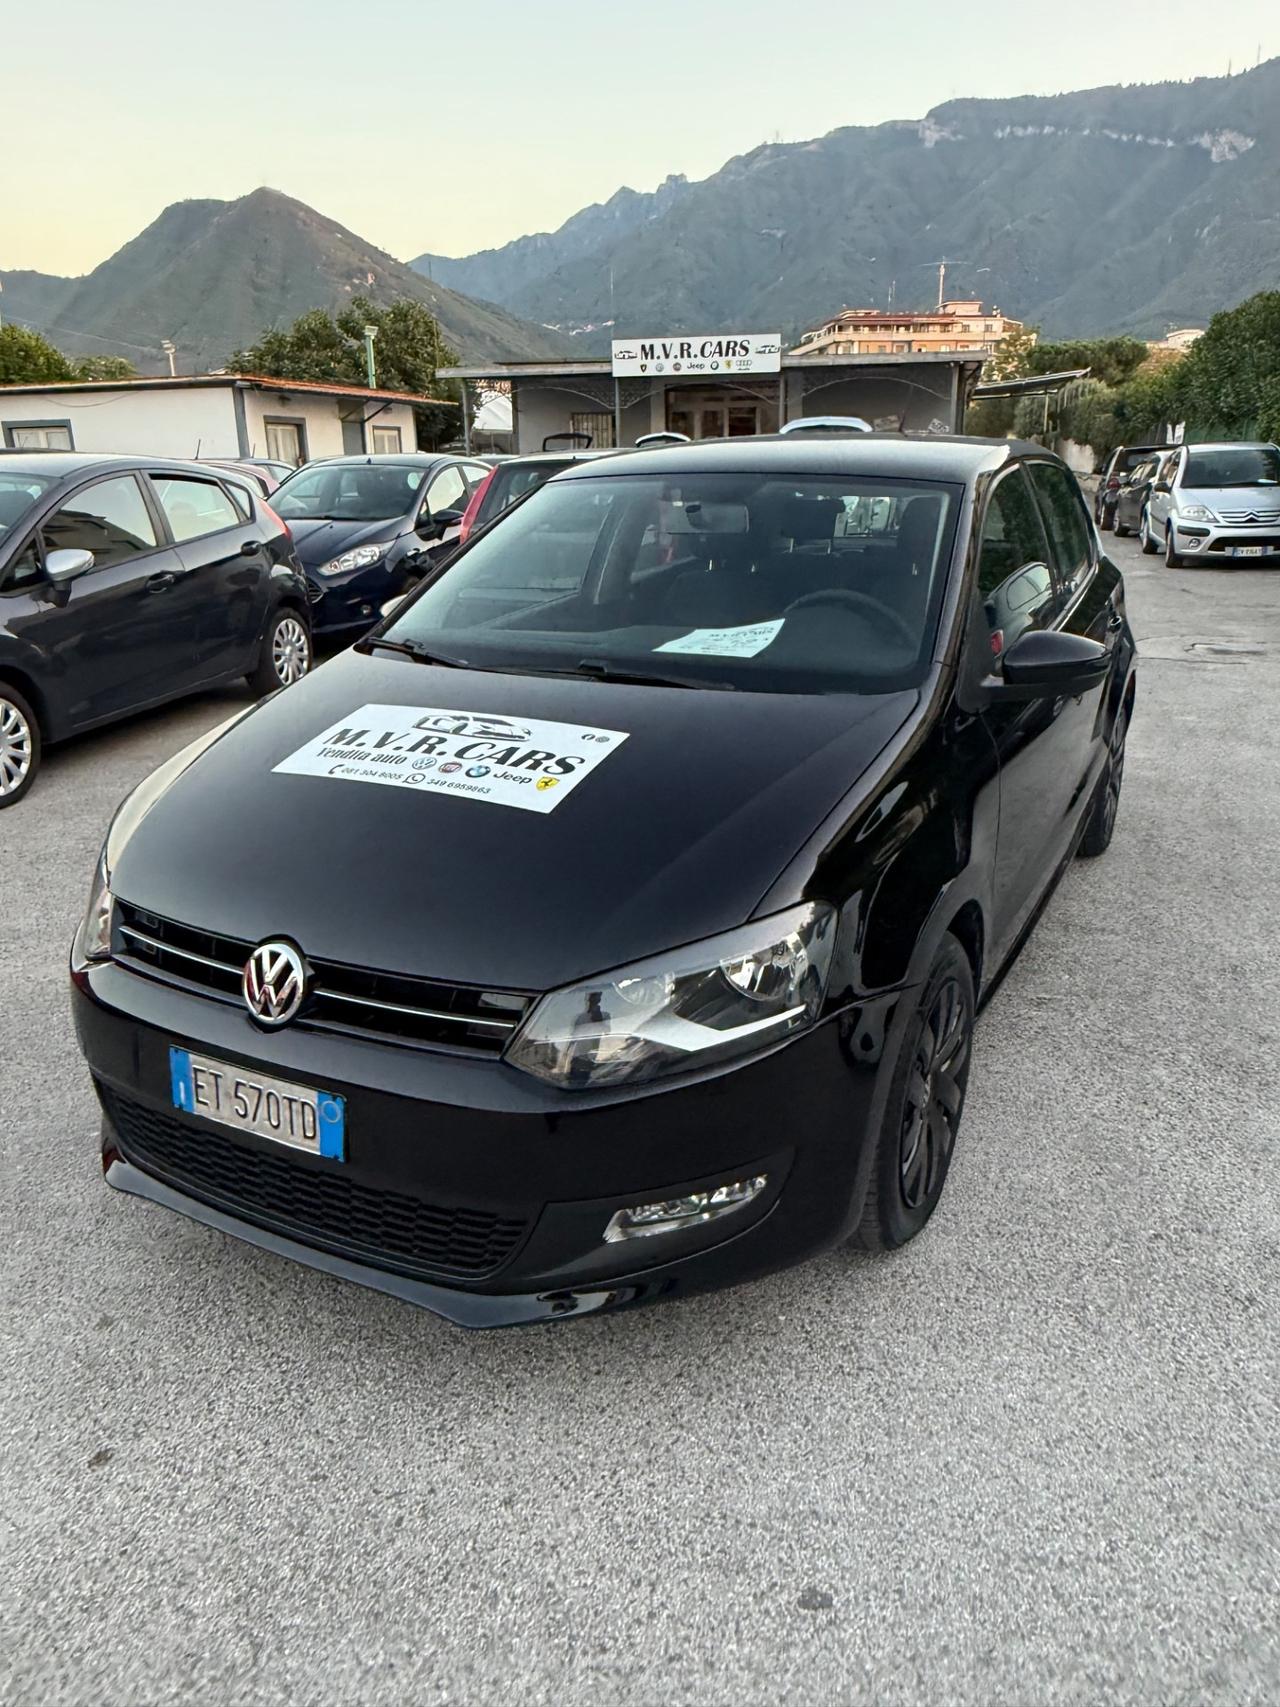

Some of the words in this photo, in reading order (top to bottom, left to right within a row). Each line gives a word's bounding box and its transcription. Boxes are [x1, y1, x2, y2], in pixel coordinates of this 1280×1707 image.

[687, 362, 705, 370] Jeep
[316, 747, 372, 761] Vendita
[370, 753, 408, 765] auto
[493, 771, 533, 785] Jeep
[427, 778, 446, 787] 349
